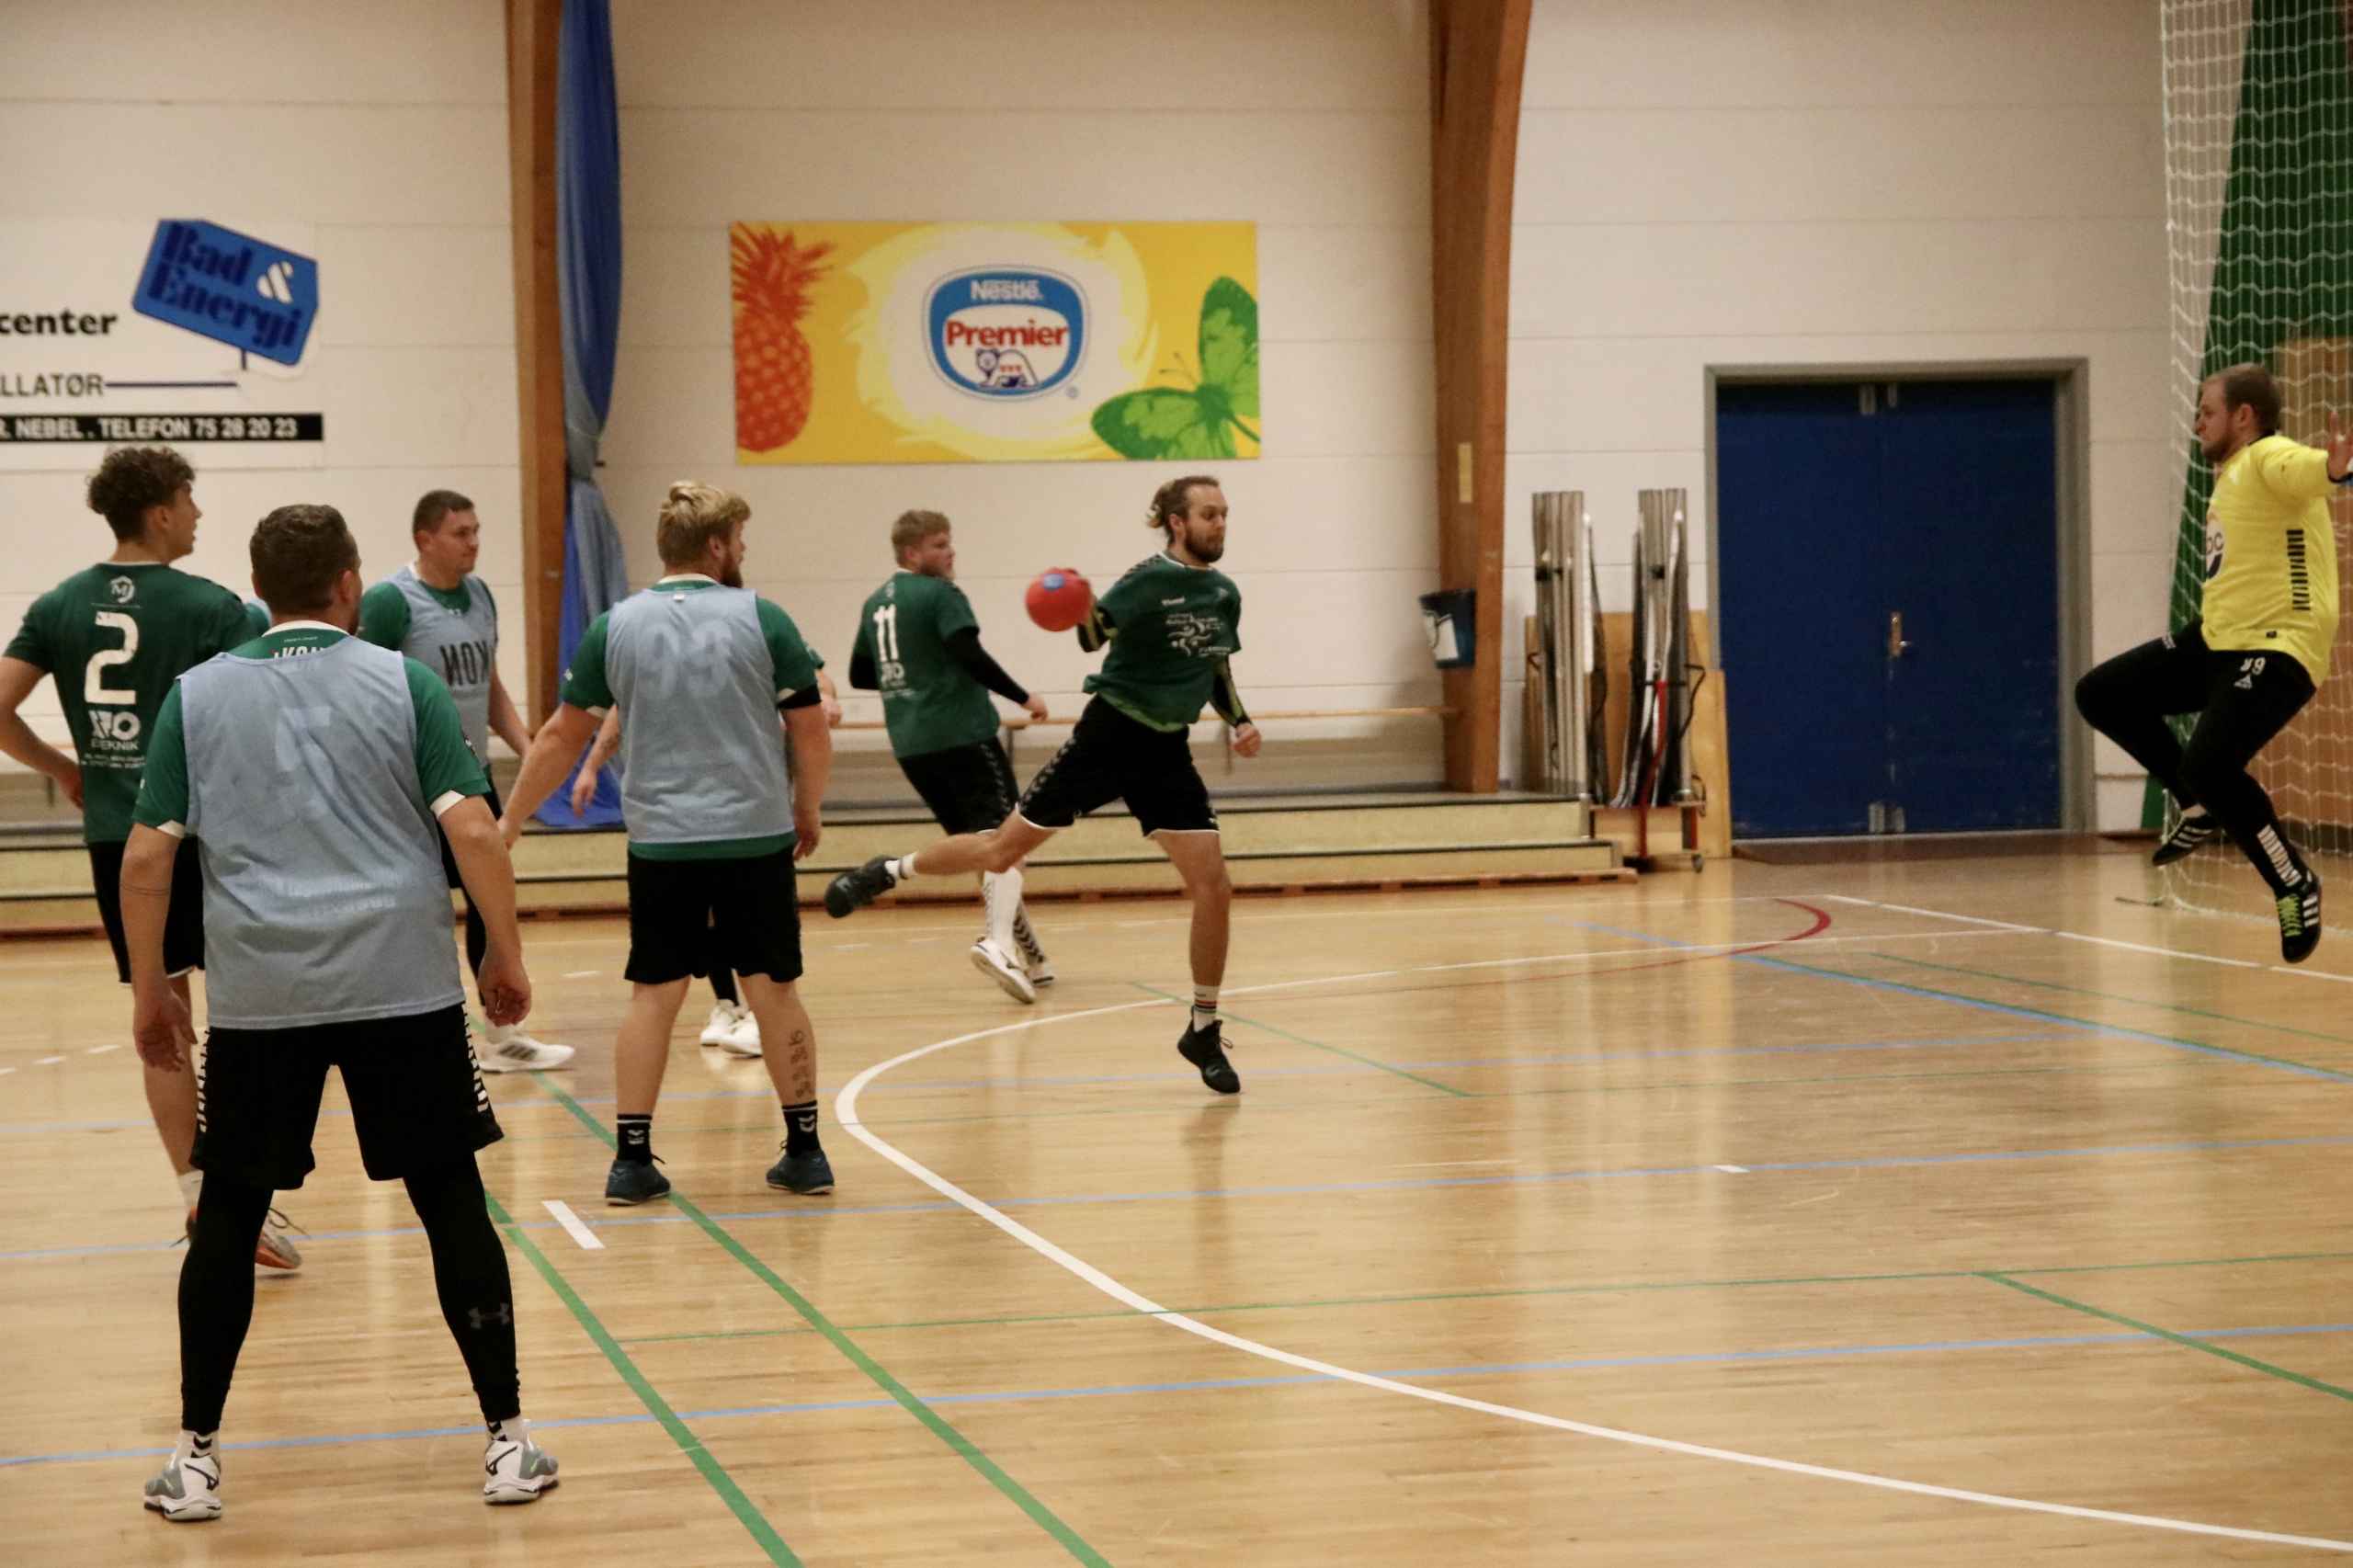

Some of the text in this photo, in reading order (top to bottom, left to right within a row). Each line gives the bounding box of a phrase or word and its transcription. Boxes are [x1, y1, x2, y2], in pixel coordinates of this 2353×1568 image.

[0, 308, 118, 335] center
[946, 319, 1068, 347] Premier
[97, 417, 190, 439] TELEFON
[193, 417, 218, 439] 75
[873, 604, 899, 662] 11
[85, 611, 139, 705] 2
